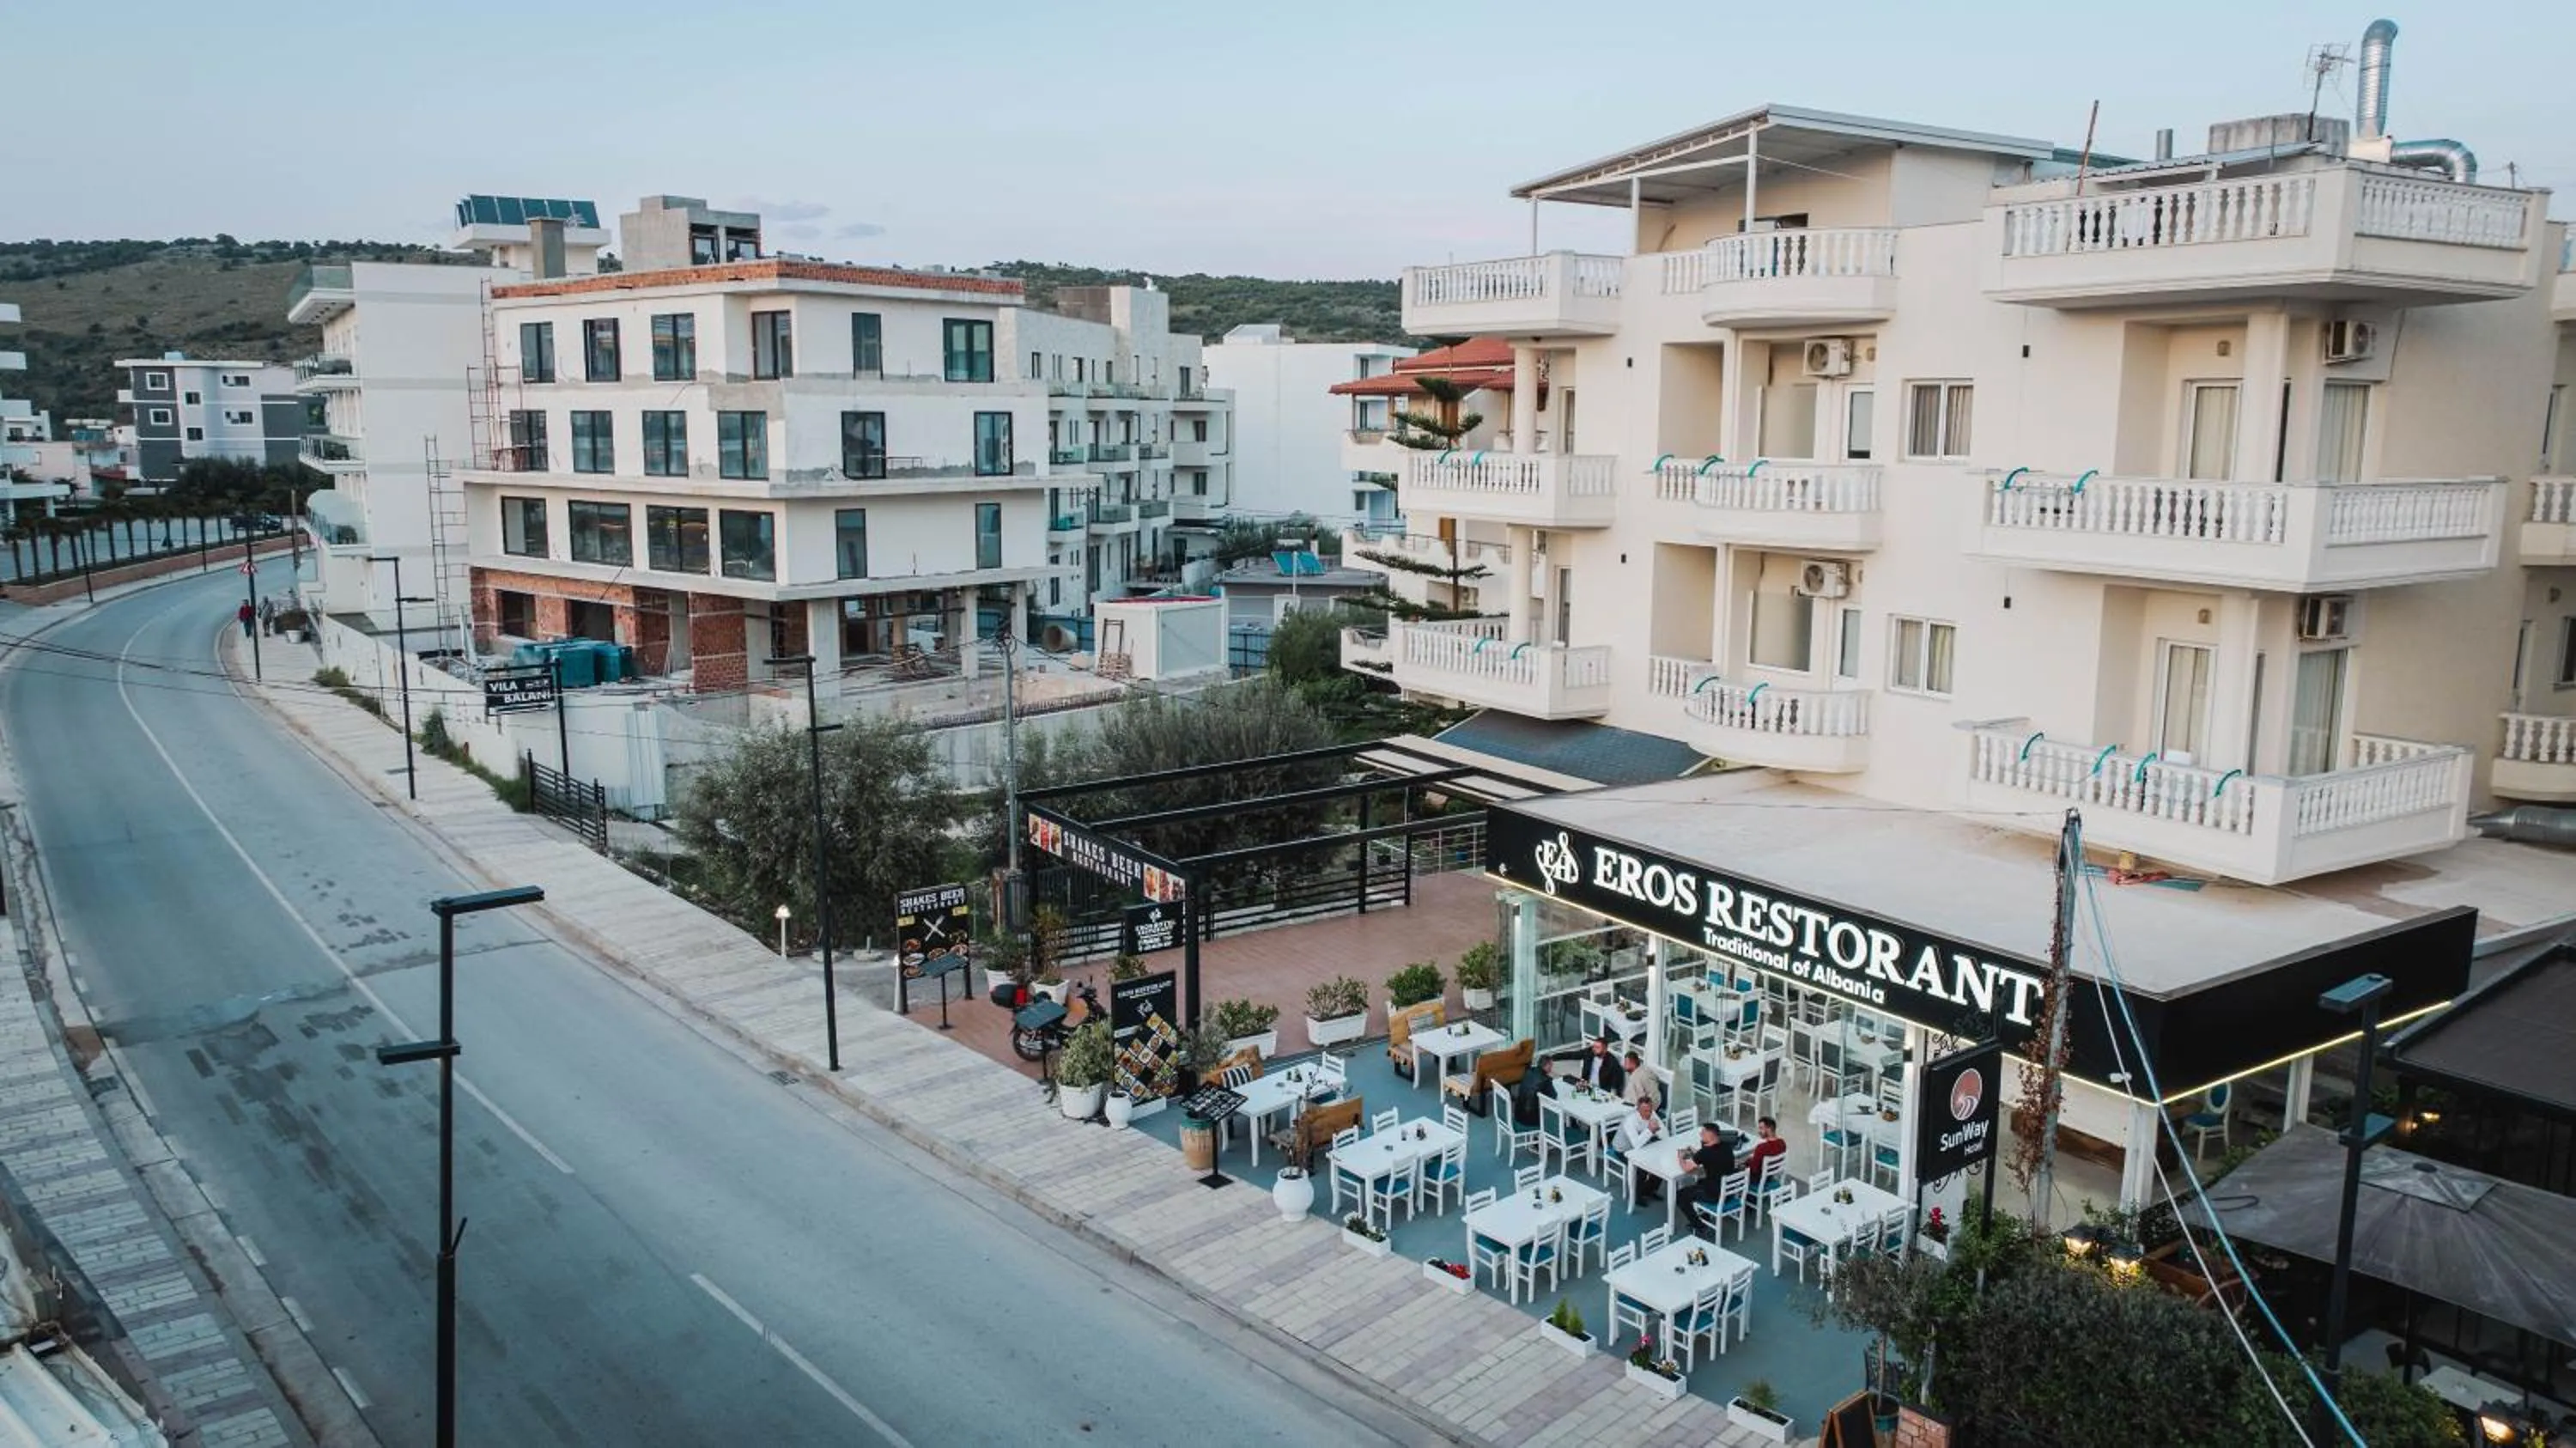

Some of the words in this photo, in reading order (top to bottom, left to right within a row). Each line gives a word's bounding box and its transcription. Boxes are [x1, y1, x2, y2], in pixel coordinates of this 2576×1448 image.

[489, 681, 518, 692] VILA
[504, 689, 550, 703] BALANI
[1063, 830, 1105, 862] SHAKES
[1111, 851, 1141, 879] BEER
[900, 893, 937, 908] SHAKES
[1593, 846, 1698, 916] EROS
[1704, 880, 2044, 1026] RESTORANT
[1703, 926, 1789, 971] Traditional
[1792, 960, 1811, 978] of
[1812, 964, 1885, 1004] Albania
[1940, 1119, 1990, 1152] SunWay
